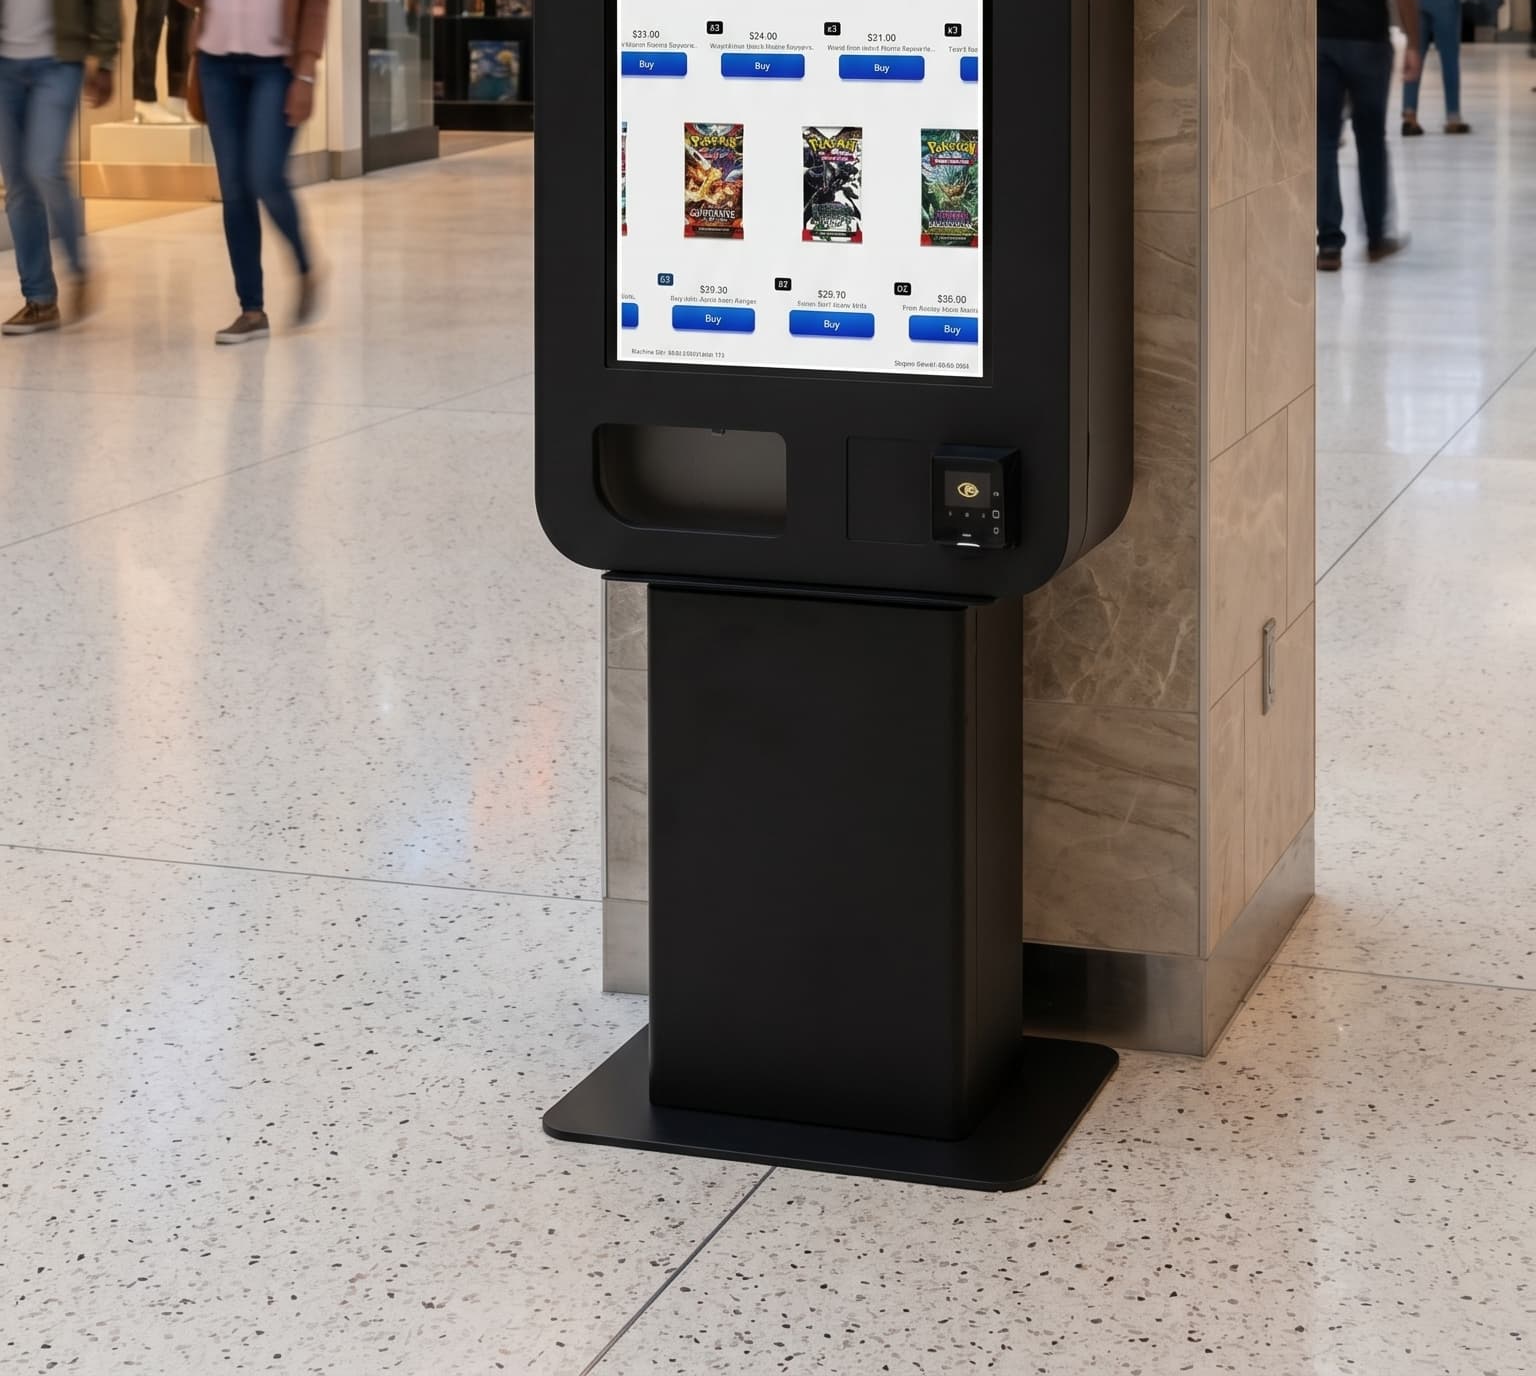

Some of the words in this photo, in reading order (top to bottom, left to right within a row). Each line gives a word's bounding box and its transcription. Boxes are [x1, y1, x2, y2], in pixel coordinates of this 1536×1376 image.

[749, 31, 778, 40] $24.00
[867, 33, 896, 42] $21.00
[639, 60, 654, 70] Buy
[754, 62, 770, 71] Buy
[874, 64, 890, 73] Buy
[705, 314, 722, 325] Buy
[823, 320, 840, 331] Buy
[944, 325, 961, 336] Buy
